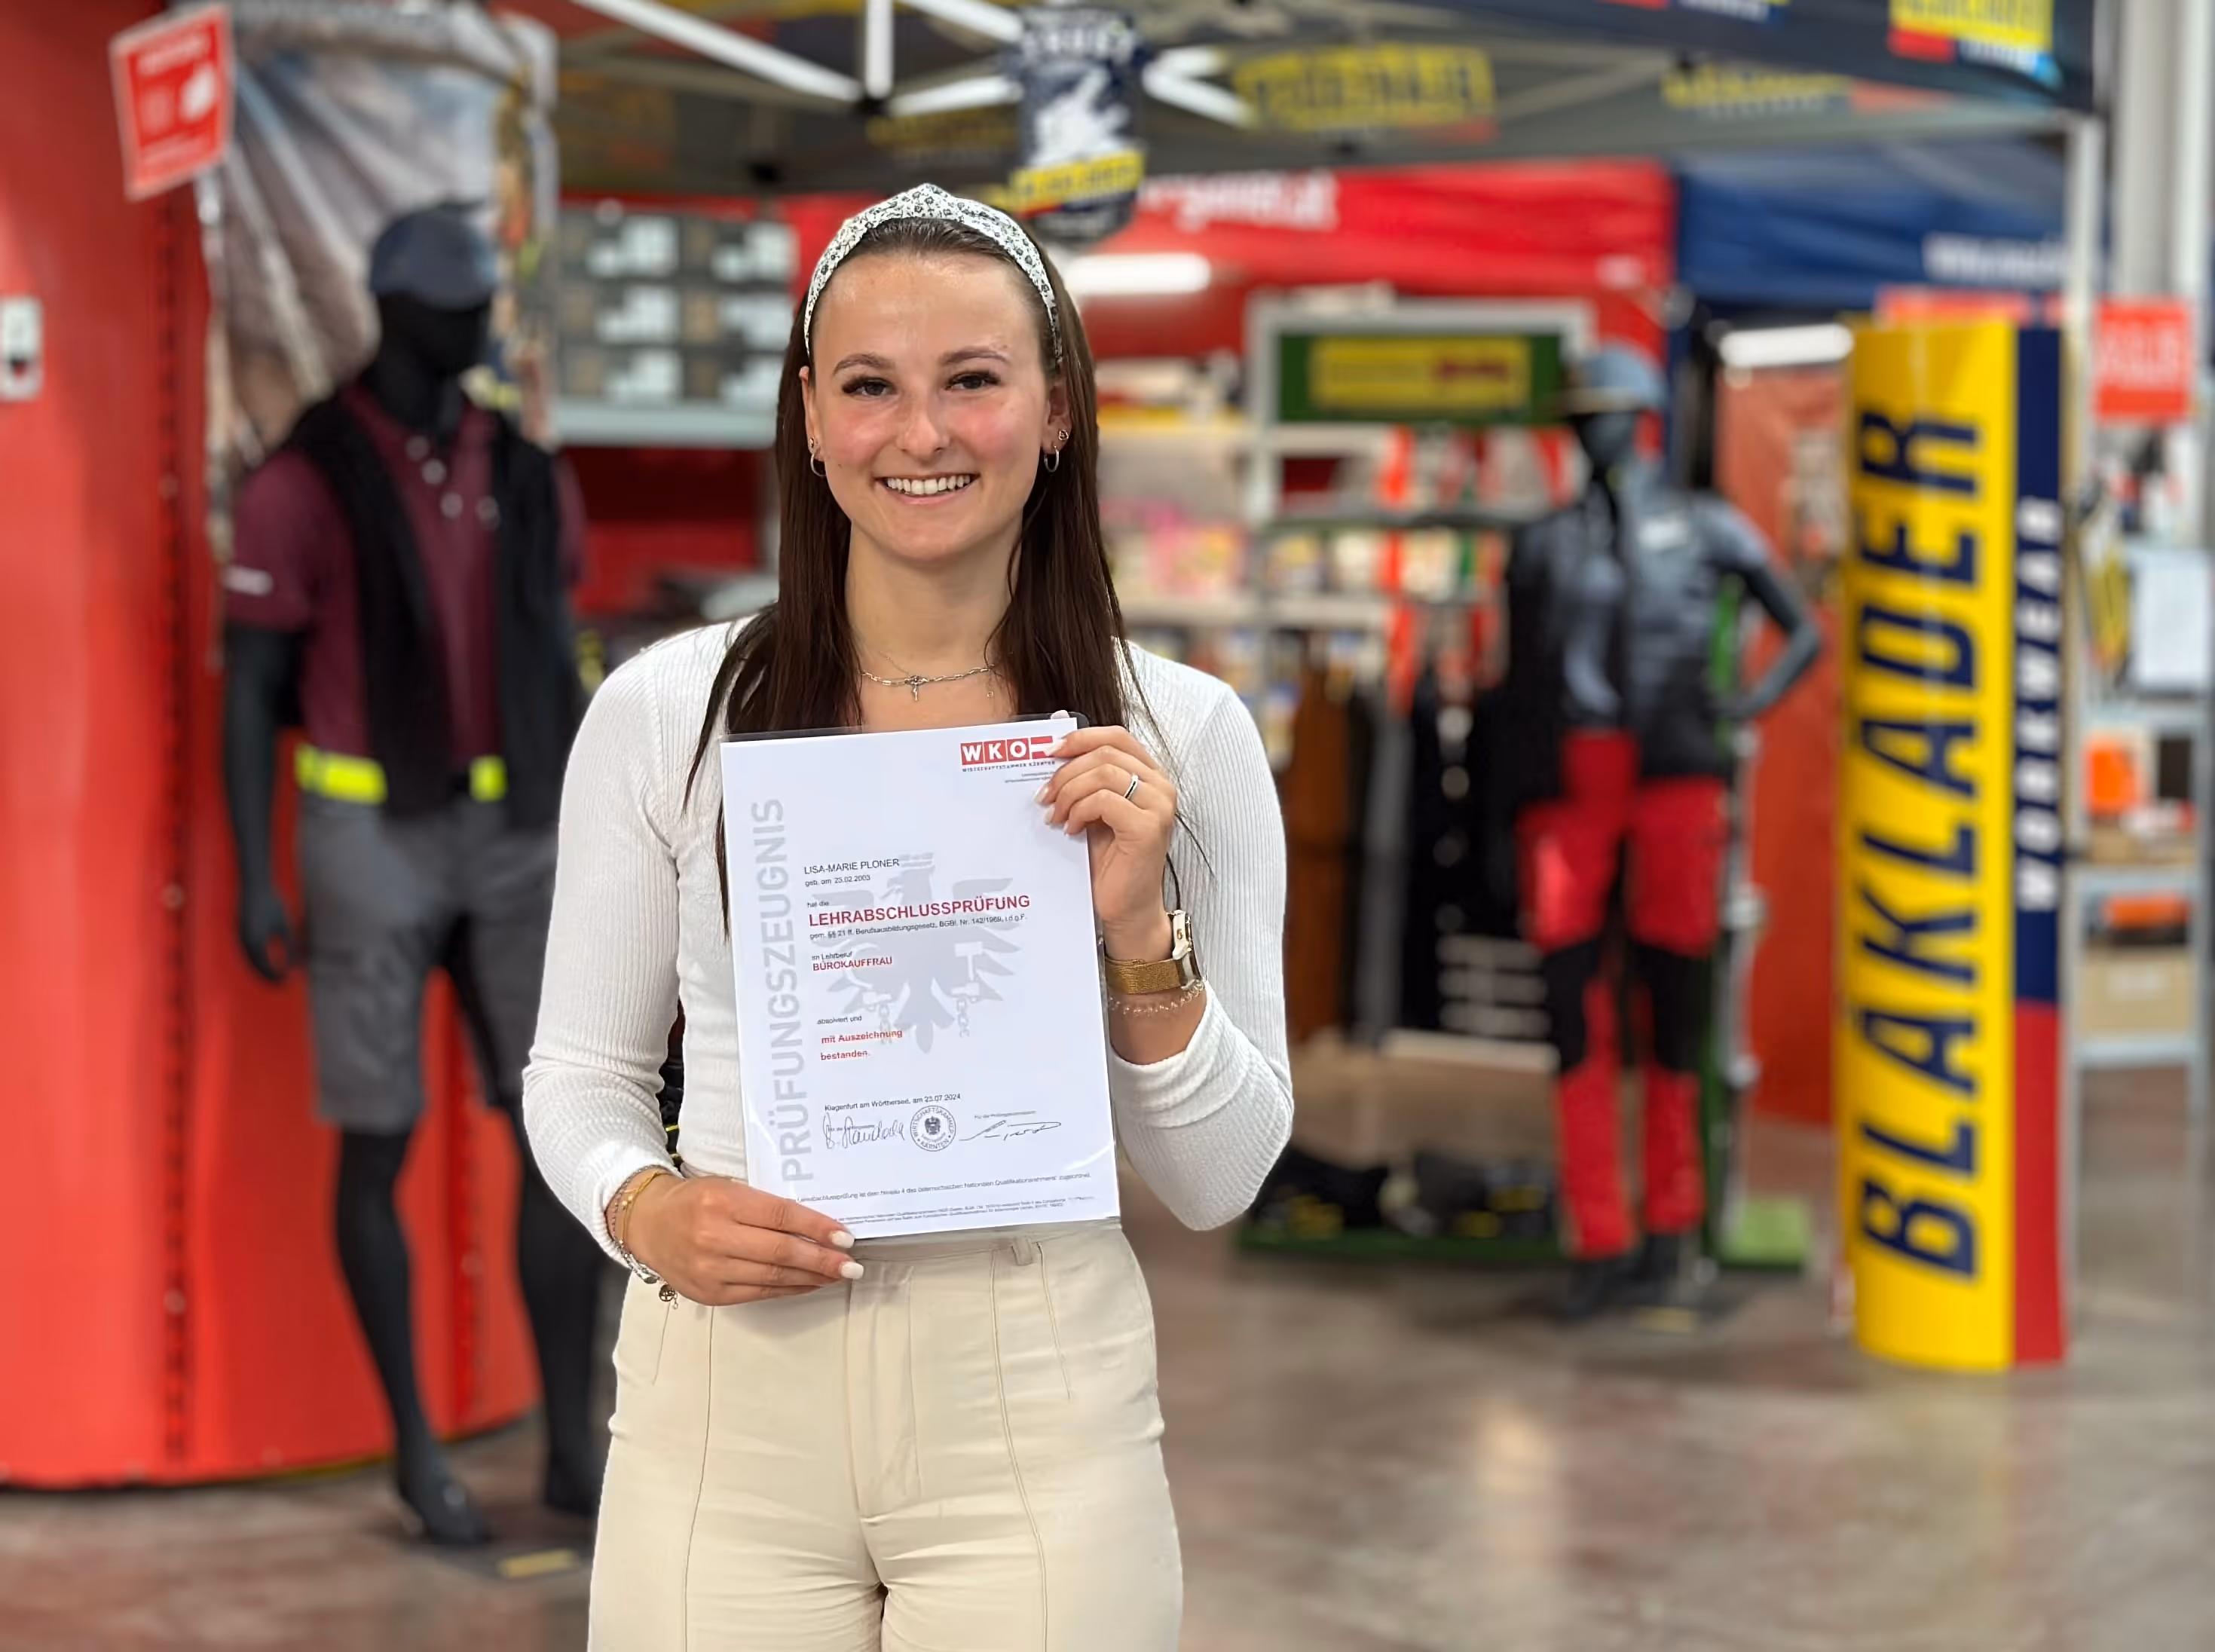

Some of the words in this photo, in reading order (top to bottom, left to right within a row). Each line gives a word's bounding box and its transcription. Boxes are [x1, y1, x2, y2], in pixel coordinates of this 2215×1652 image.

[2017, 495, 2062, 910] WORKWEAR
[962, 740, 1027, 762] WKO
[804, 861, 858, 874] LISA-MARIE
[860, 858, 900, 870] PLONER
[809, 895, 1030, 926] LEHRABSCHLUSSPRÜFUNG
[821, 951, 853, 961] Lehrberuf
[752, 798, 814, 1182] PRÜFUNGSZEUGNIS
[821, 1035, 836, 1044] mit
[838, 1029, 903, 1042] Auszeichnung
[825, 1103, 858, 1112] Klagenfurt
